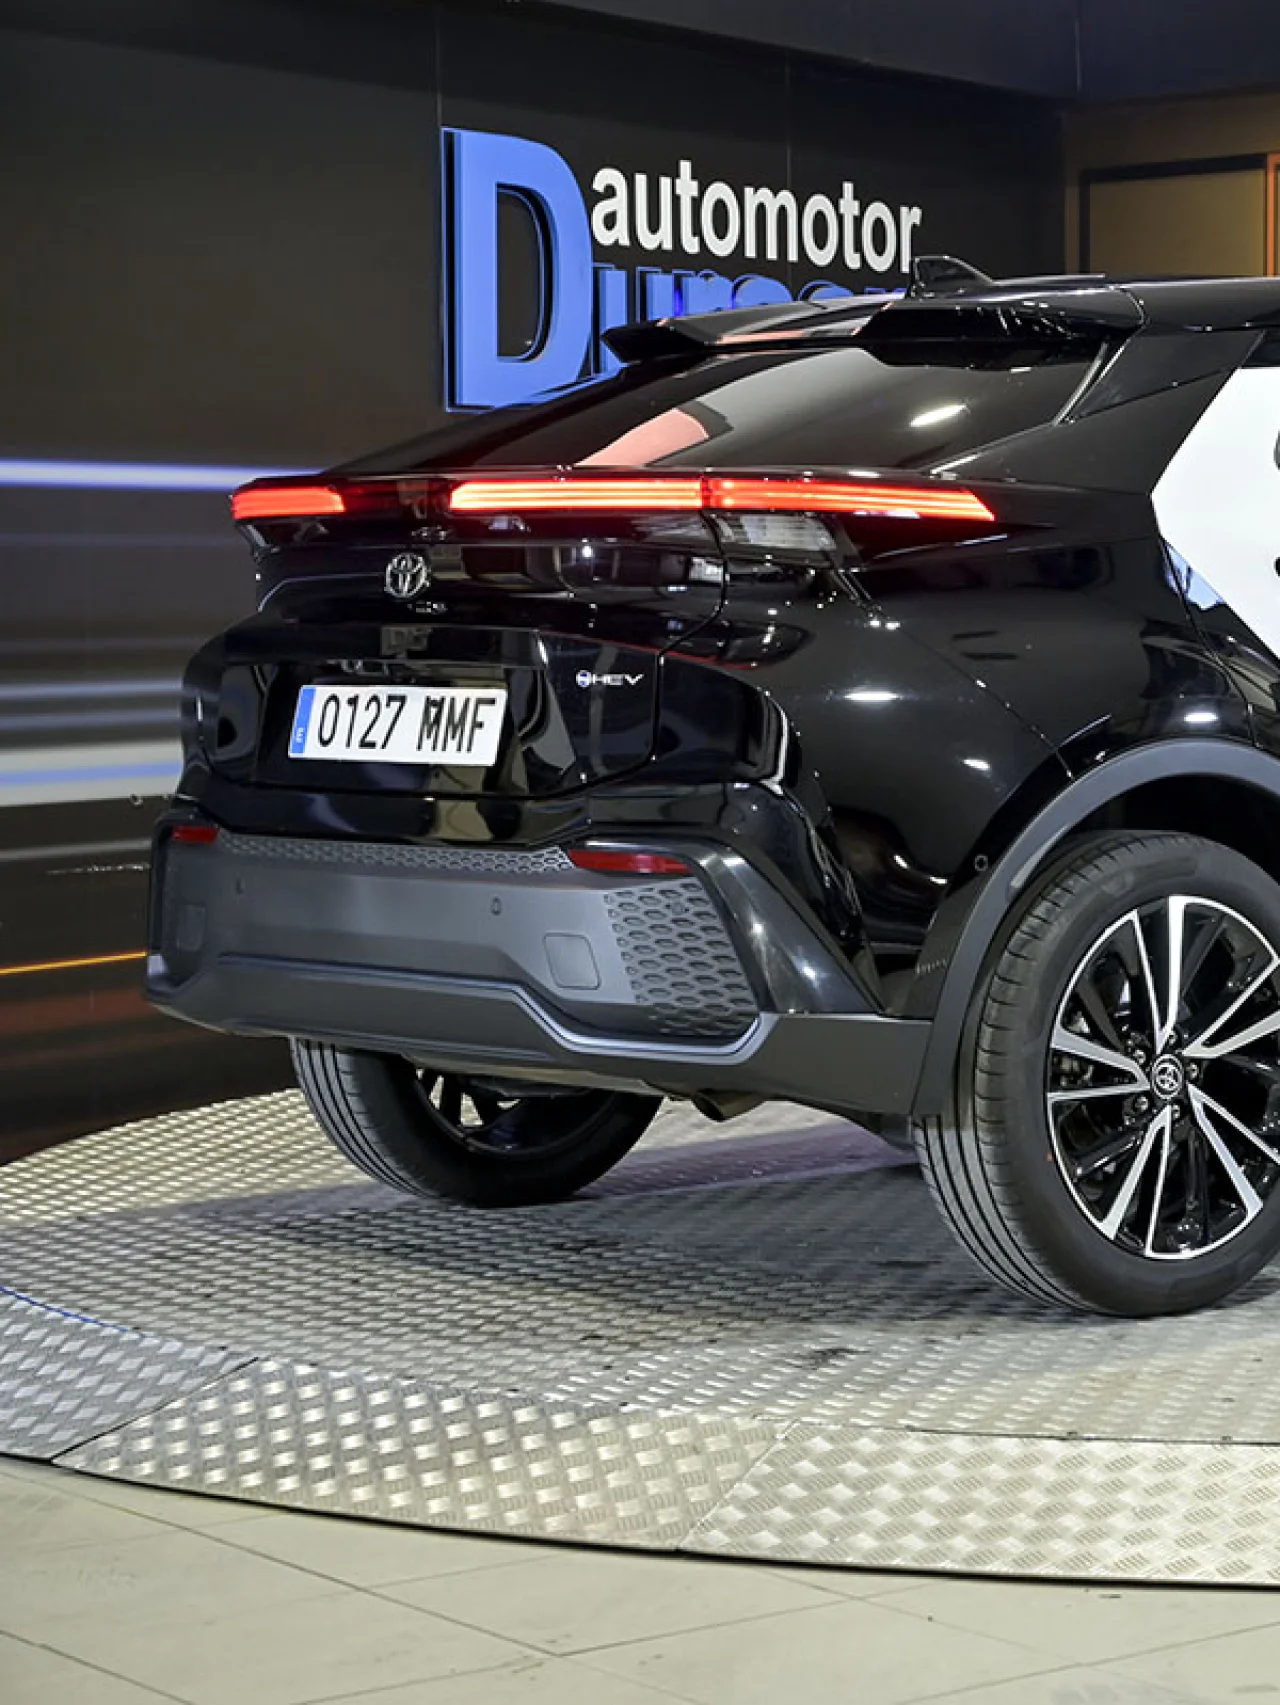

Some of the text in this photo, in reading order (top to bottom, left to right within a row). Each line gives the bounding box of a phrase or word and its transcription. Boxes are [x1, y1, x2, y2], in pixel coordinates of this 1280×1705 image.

[591, 159, 922, 273] automotor
[318, 693, 408, 750] 0127
[416, 694, 497, 754] MMF
